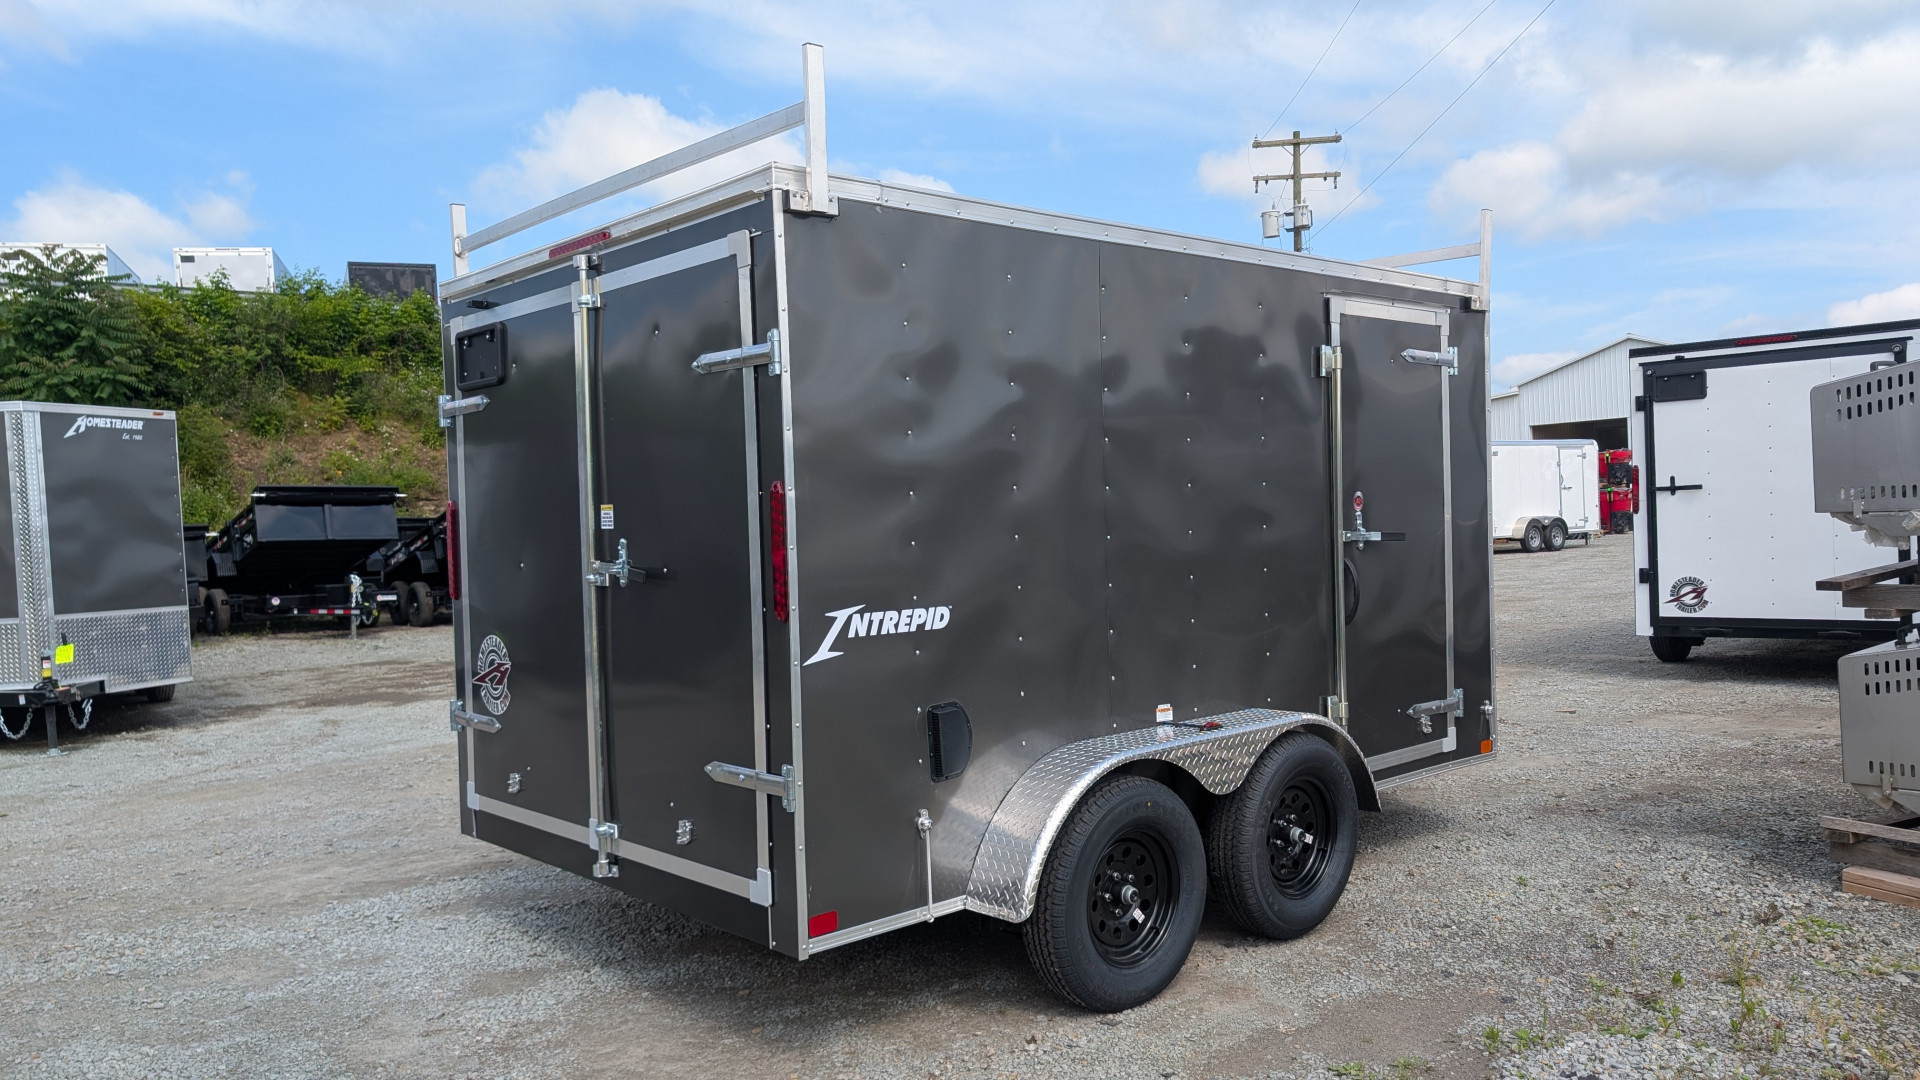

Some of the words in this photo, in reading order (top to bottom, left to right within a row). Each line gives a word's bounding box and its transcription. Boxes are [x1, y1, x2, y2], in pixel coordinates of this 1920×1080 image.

[63, 415, 144, 438] HOMESTEADER
[1670, 576, 1705, 597] HOMESTEADER
[1674, 599, 1709, 614] TRAILER.COM
[802, 604, 951, 666] INTREPID
